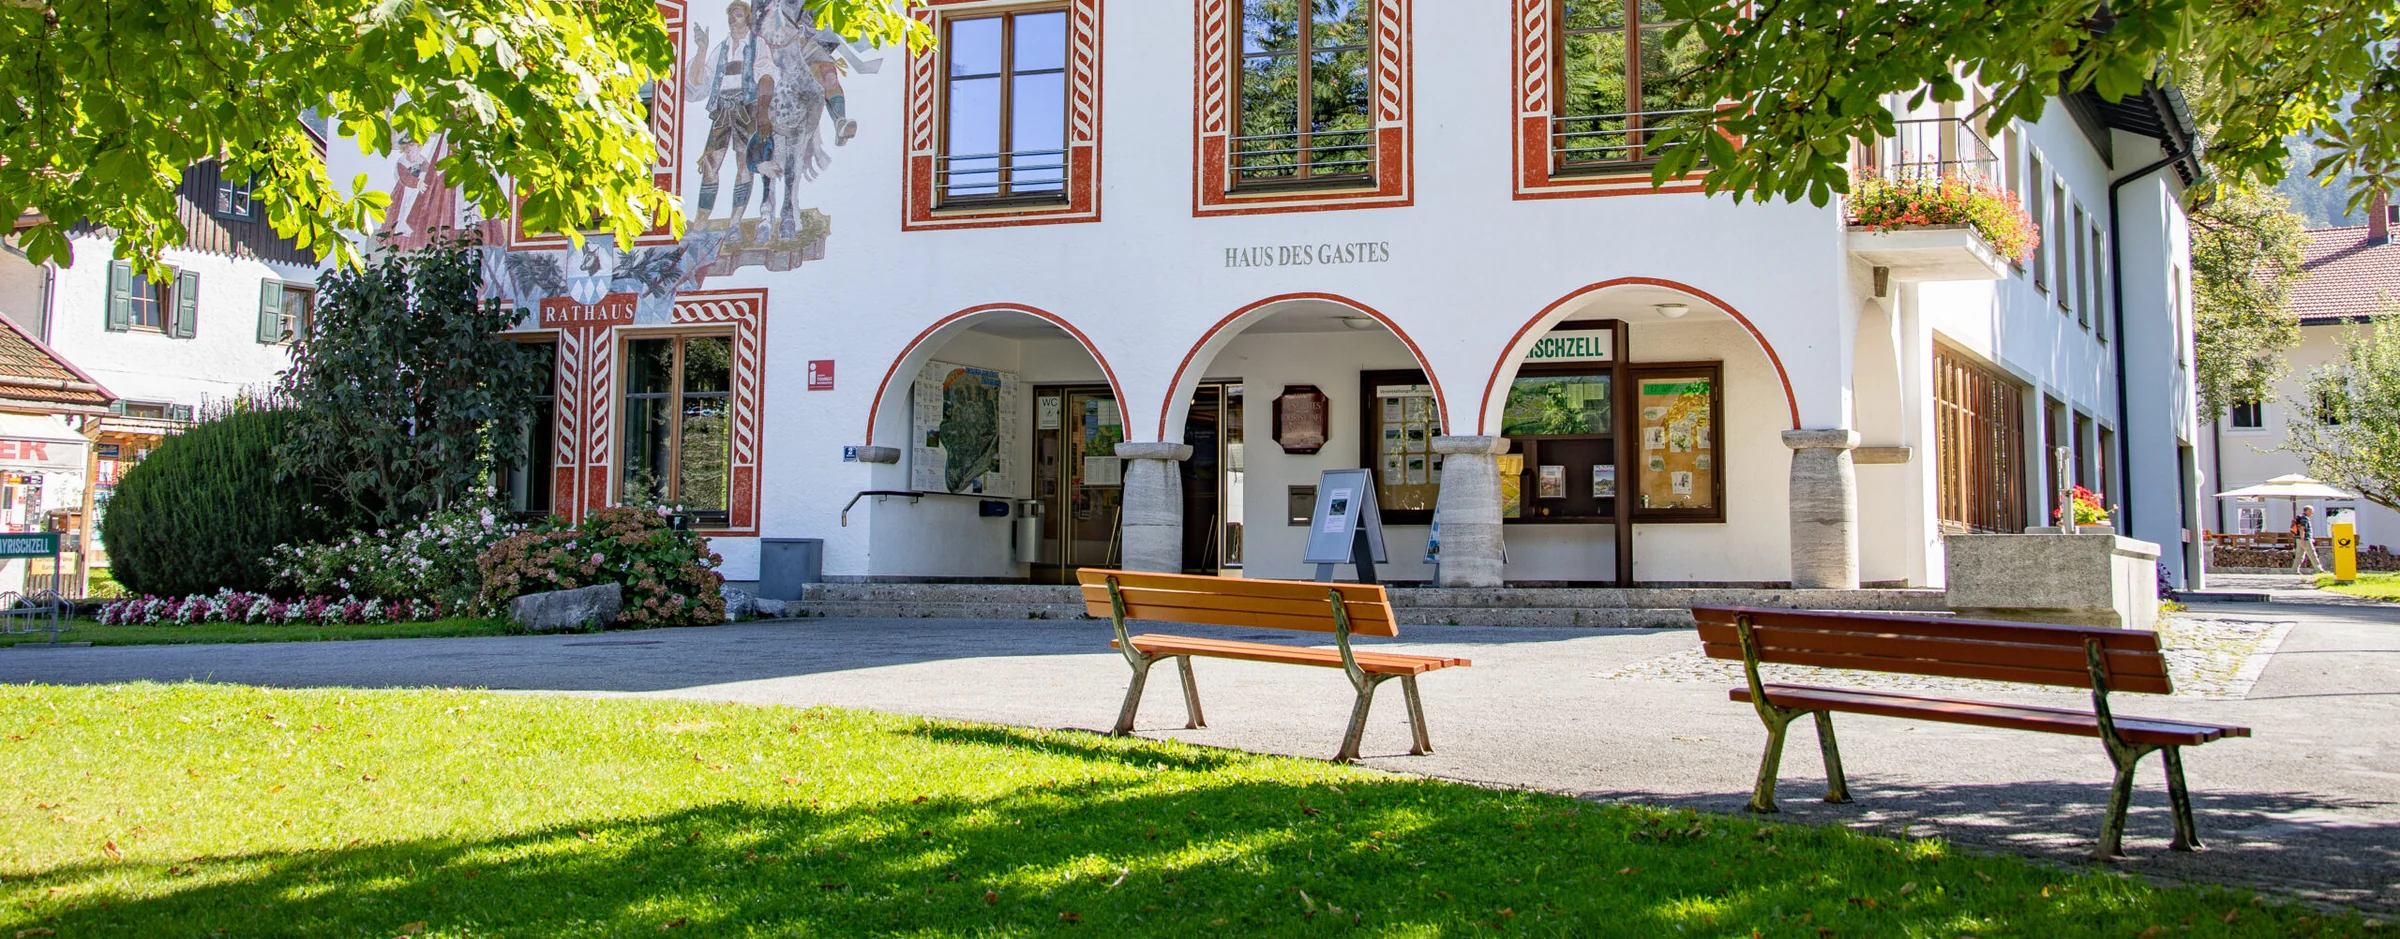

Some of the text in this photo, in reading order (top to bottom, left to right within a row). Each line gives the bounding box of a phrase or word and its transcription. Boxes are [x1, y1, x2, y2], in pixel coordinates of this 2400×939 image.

[1225, 241, 1390, 268] HAUS DES GASTES
[545, 303, 634, 322] RATHAUS
[1525, 337, 1604, 359] ISCHZELL
[1042, 398, 1058, 407] WC
[847, 447, 853, 455] 2
